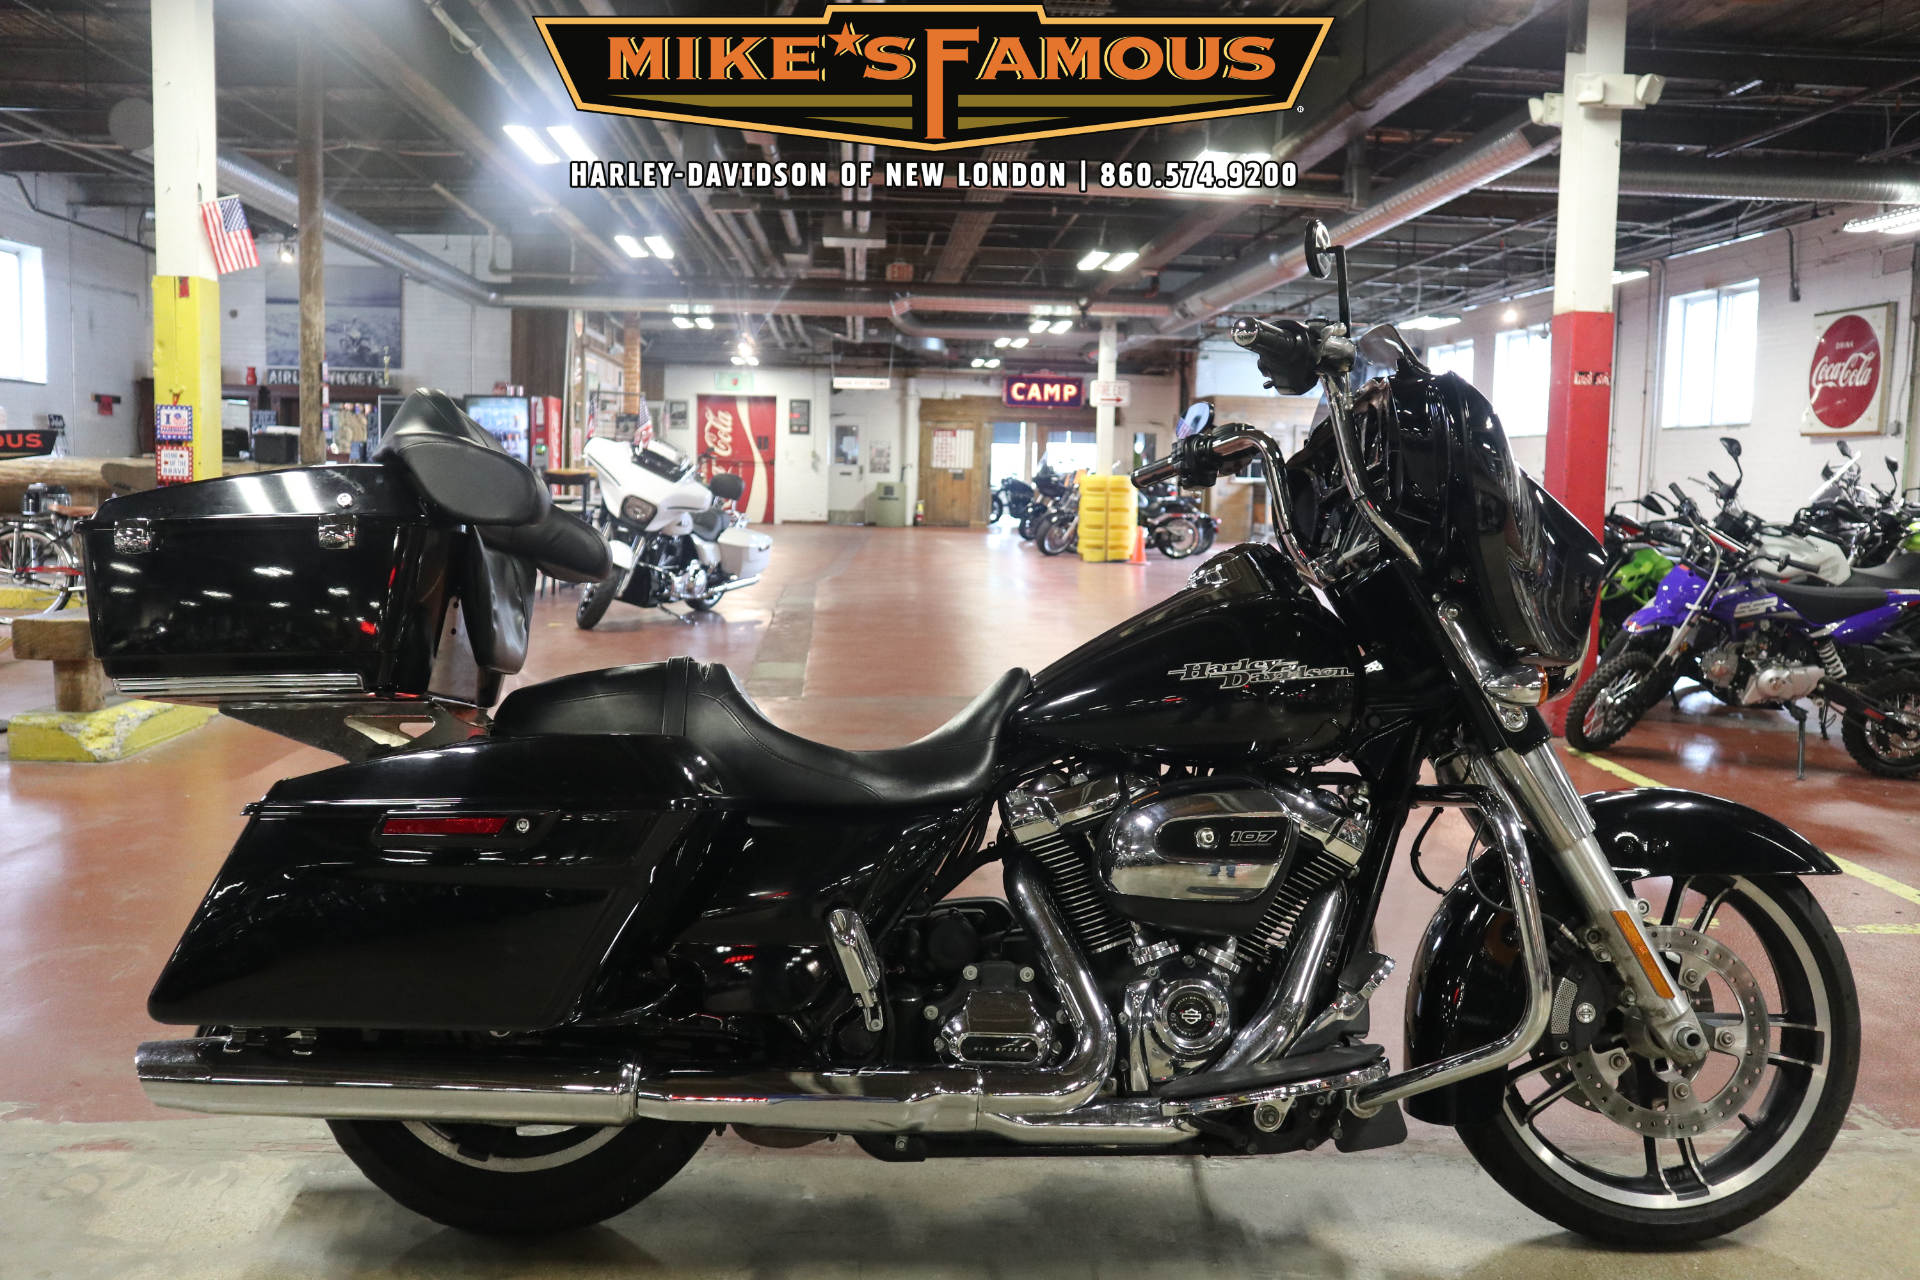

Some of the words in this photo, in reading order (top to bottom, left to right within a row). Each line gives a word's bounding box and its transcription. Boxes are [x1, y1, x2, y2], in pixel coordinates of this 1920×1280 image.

[1835, 341, 1855, 350] DRINK
[1010, 382, 1078, 402] CAMP
[165, 413, 172, 425] I
[163, 452, 178, 460] HOME
[1733, 596, 1779, 618] SSR
[1167, 658, 1299, 681] Harley
[1219, 665, 1354, 690] Davidson
[1230, 830, 1278, 843] 107
